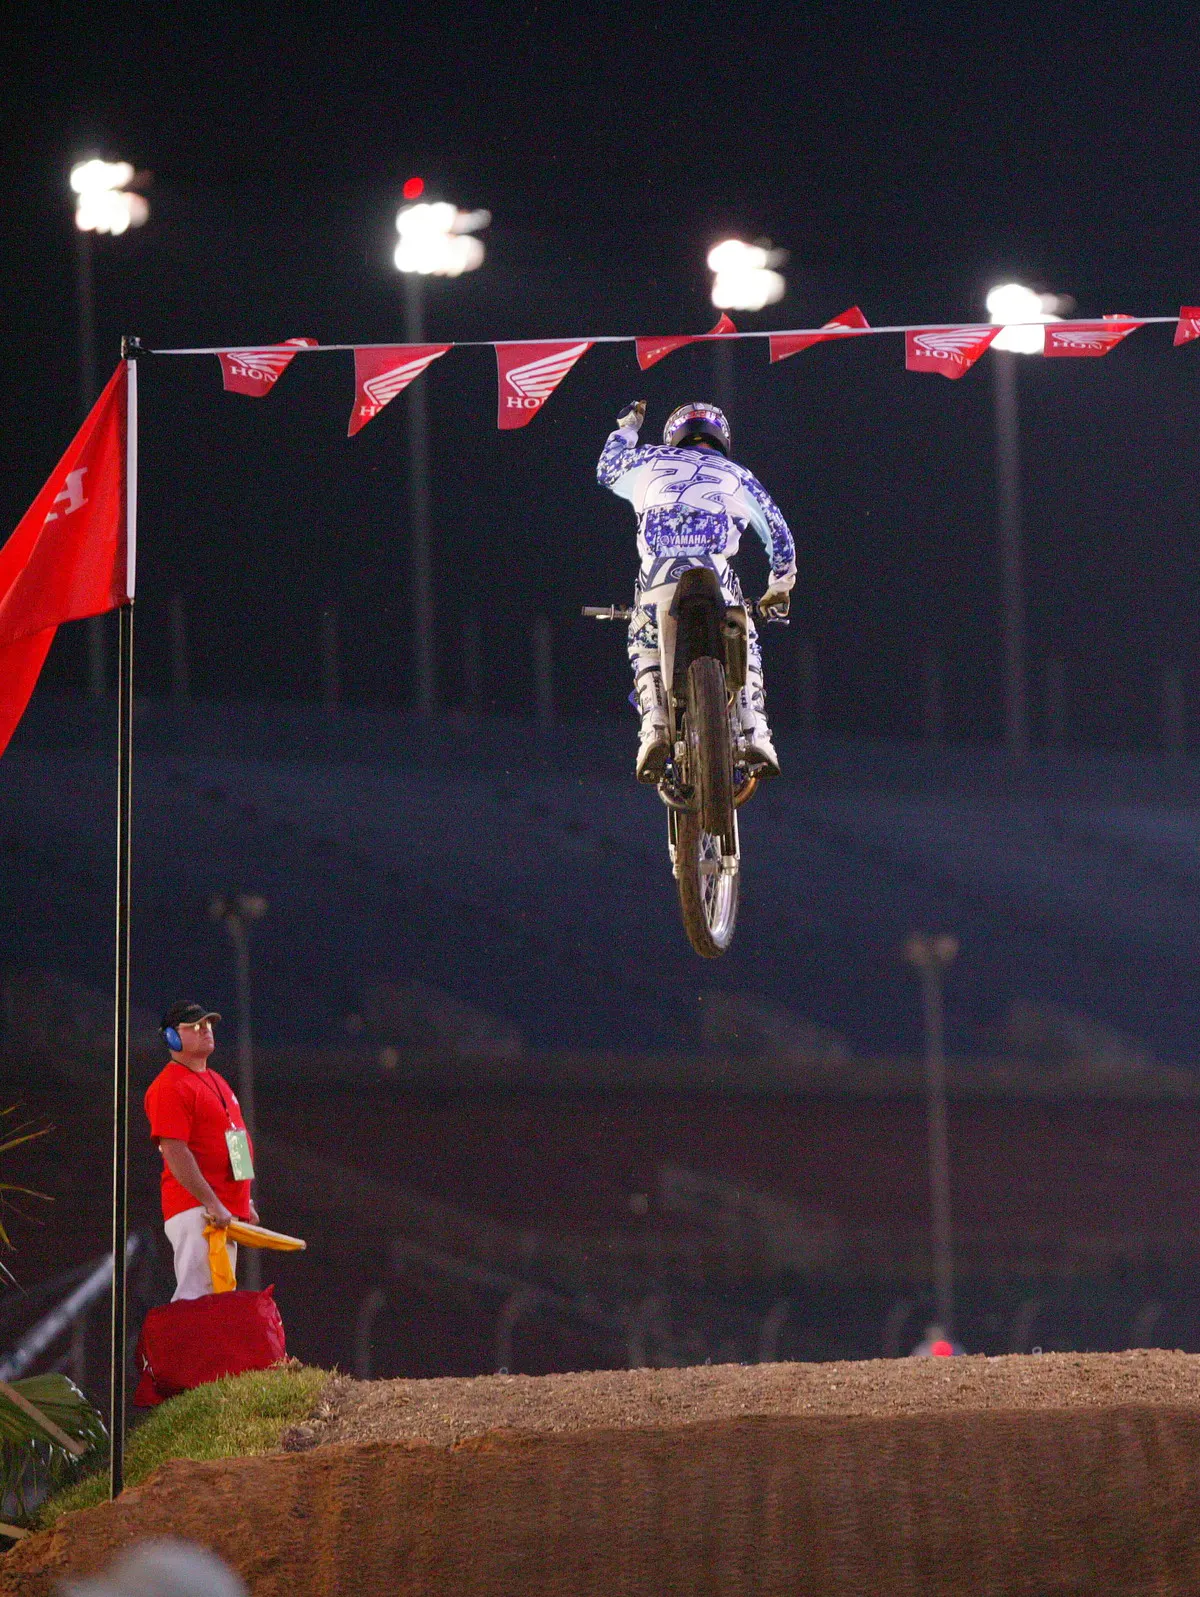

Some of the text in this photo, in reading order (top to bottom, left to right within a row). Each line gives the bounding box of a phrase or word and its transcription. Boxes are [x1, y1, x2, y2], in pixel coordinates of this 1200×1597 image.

[360, 405, 382, 416] H
[643, 459, 741, 514] 22
[669, 534, 707, 544] YAMAHA
